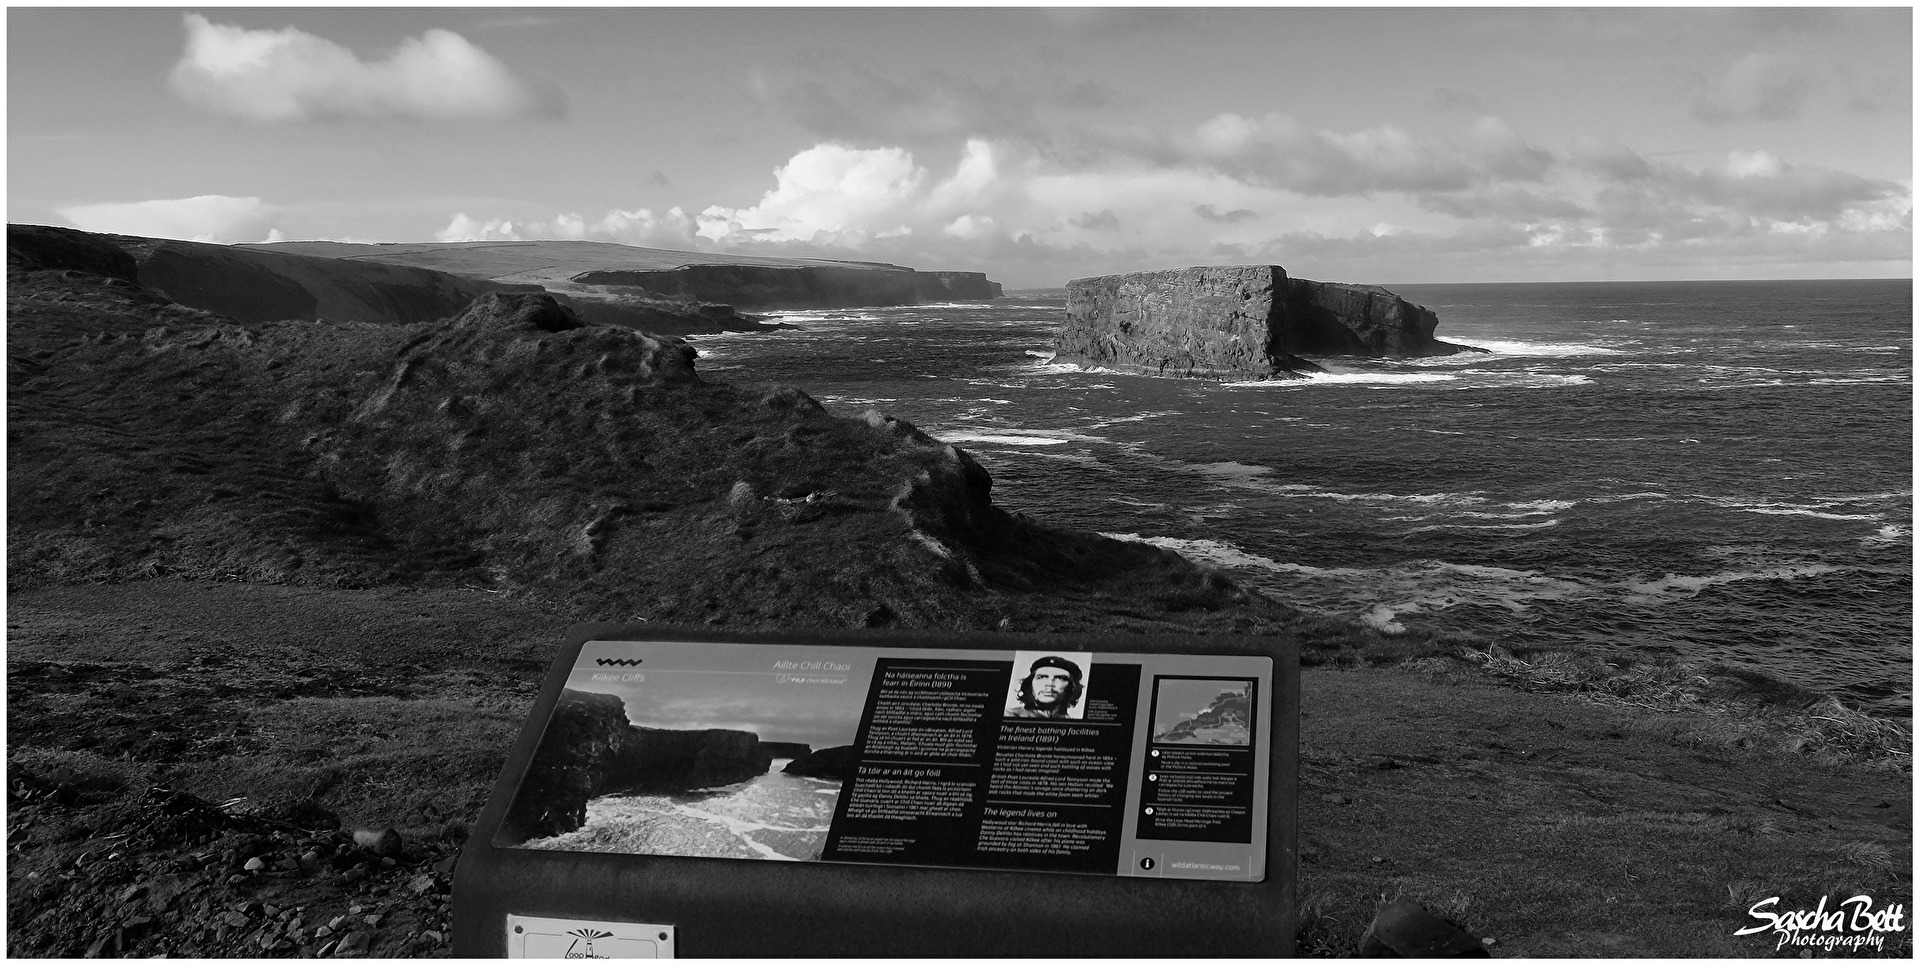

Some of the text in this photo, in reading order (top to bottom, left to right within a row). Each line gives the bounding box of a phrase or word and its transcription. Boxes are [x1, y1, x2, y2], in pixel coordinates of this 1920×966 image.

[774, 661, 850, 671] Aillte Chill Chaoi
[622, 673, 644, 681] Cliffs
[1038, 727, 1066, 736] bathing
[1067, 728, 1099, 736] facilities
[1000, 808, 1026, 818] legend
[1171, 861, 1240, 871] wildatlanticway.com
